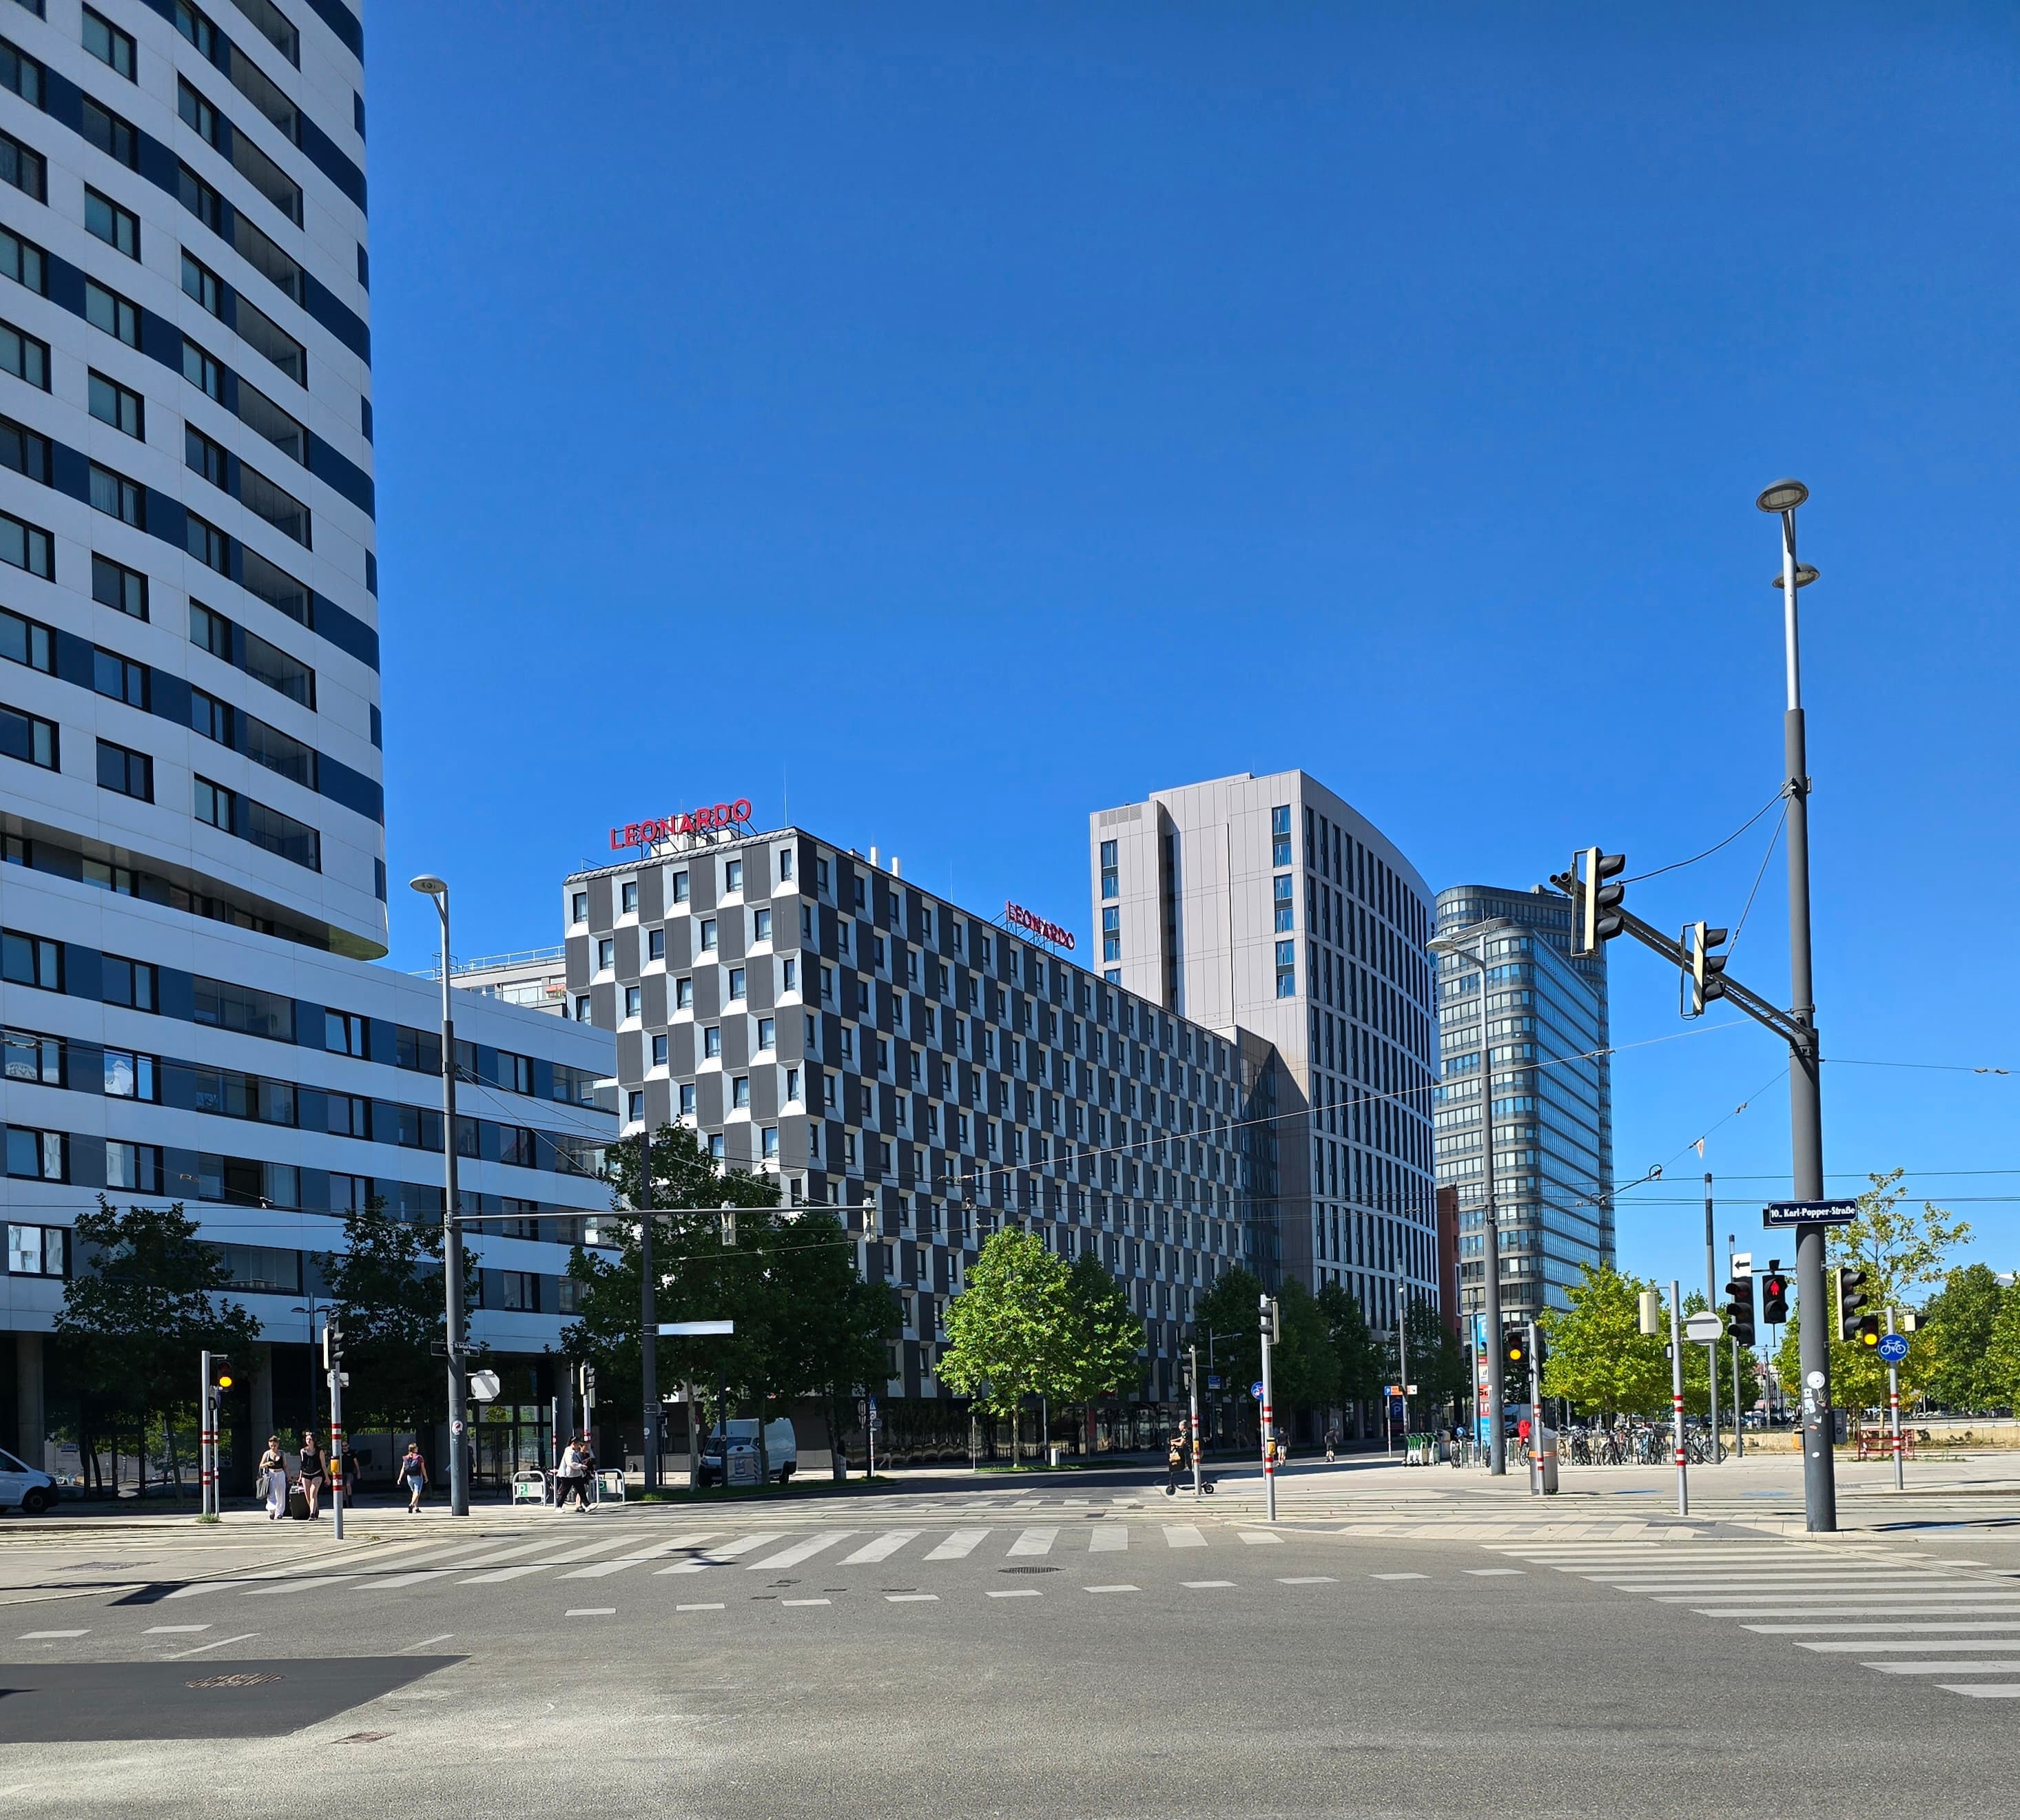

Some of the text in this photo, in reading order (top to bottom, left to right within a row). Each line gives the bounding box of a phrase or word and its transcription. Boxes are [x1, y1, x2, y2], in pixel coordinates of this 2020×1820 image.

[610, 798, 751, 849] LEONARDO
[1006, 900, 1075, 950] LEONARDO
[1784, 1206, 1855, 1218] Karl-Popper-Straße
